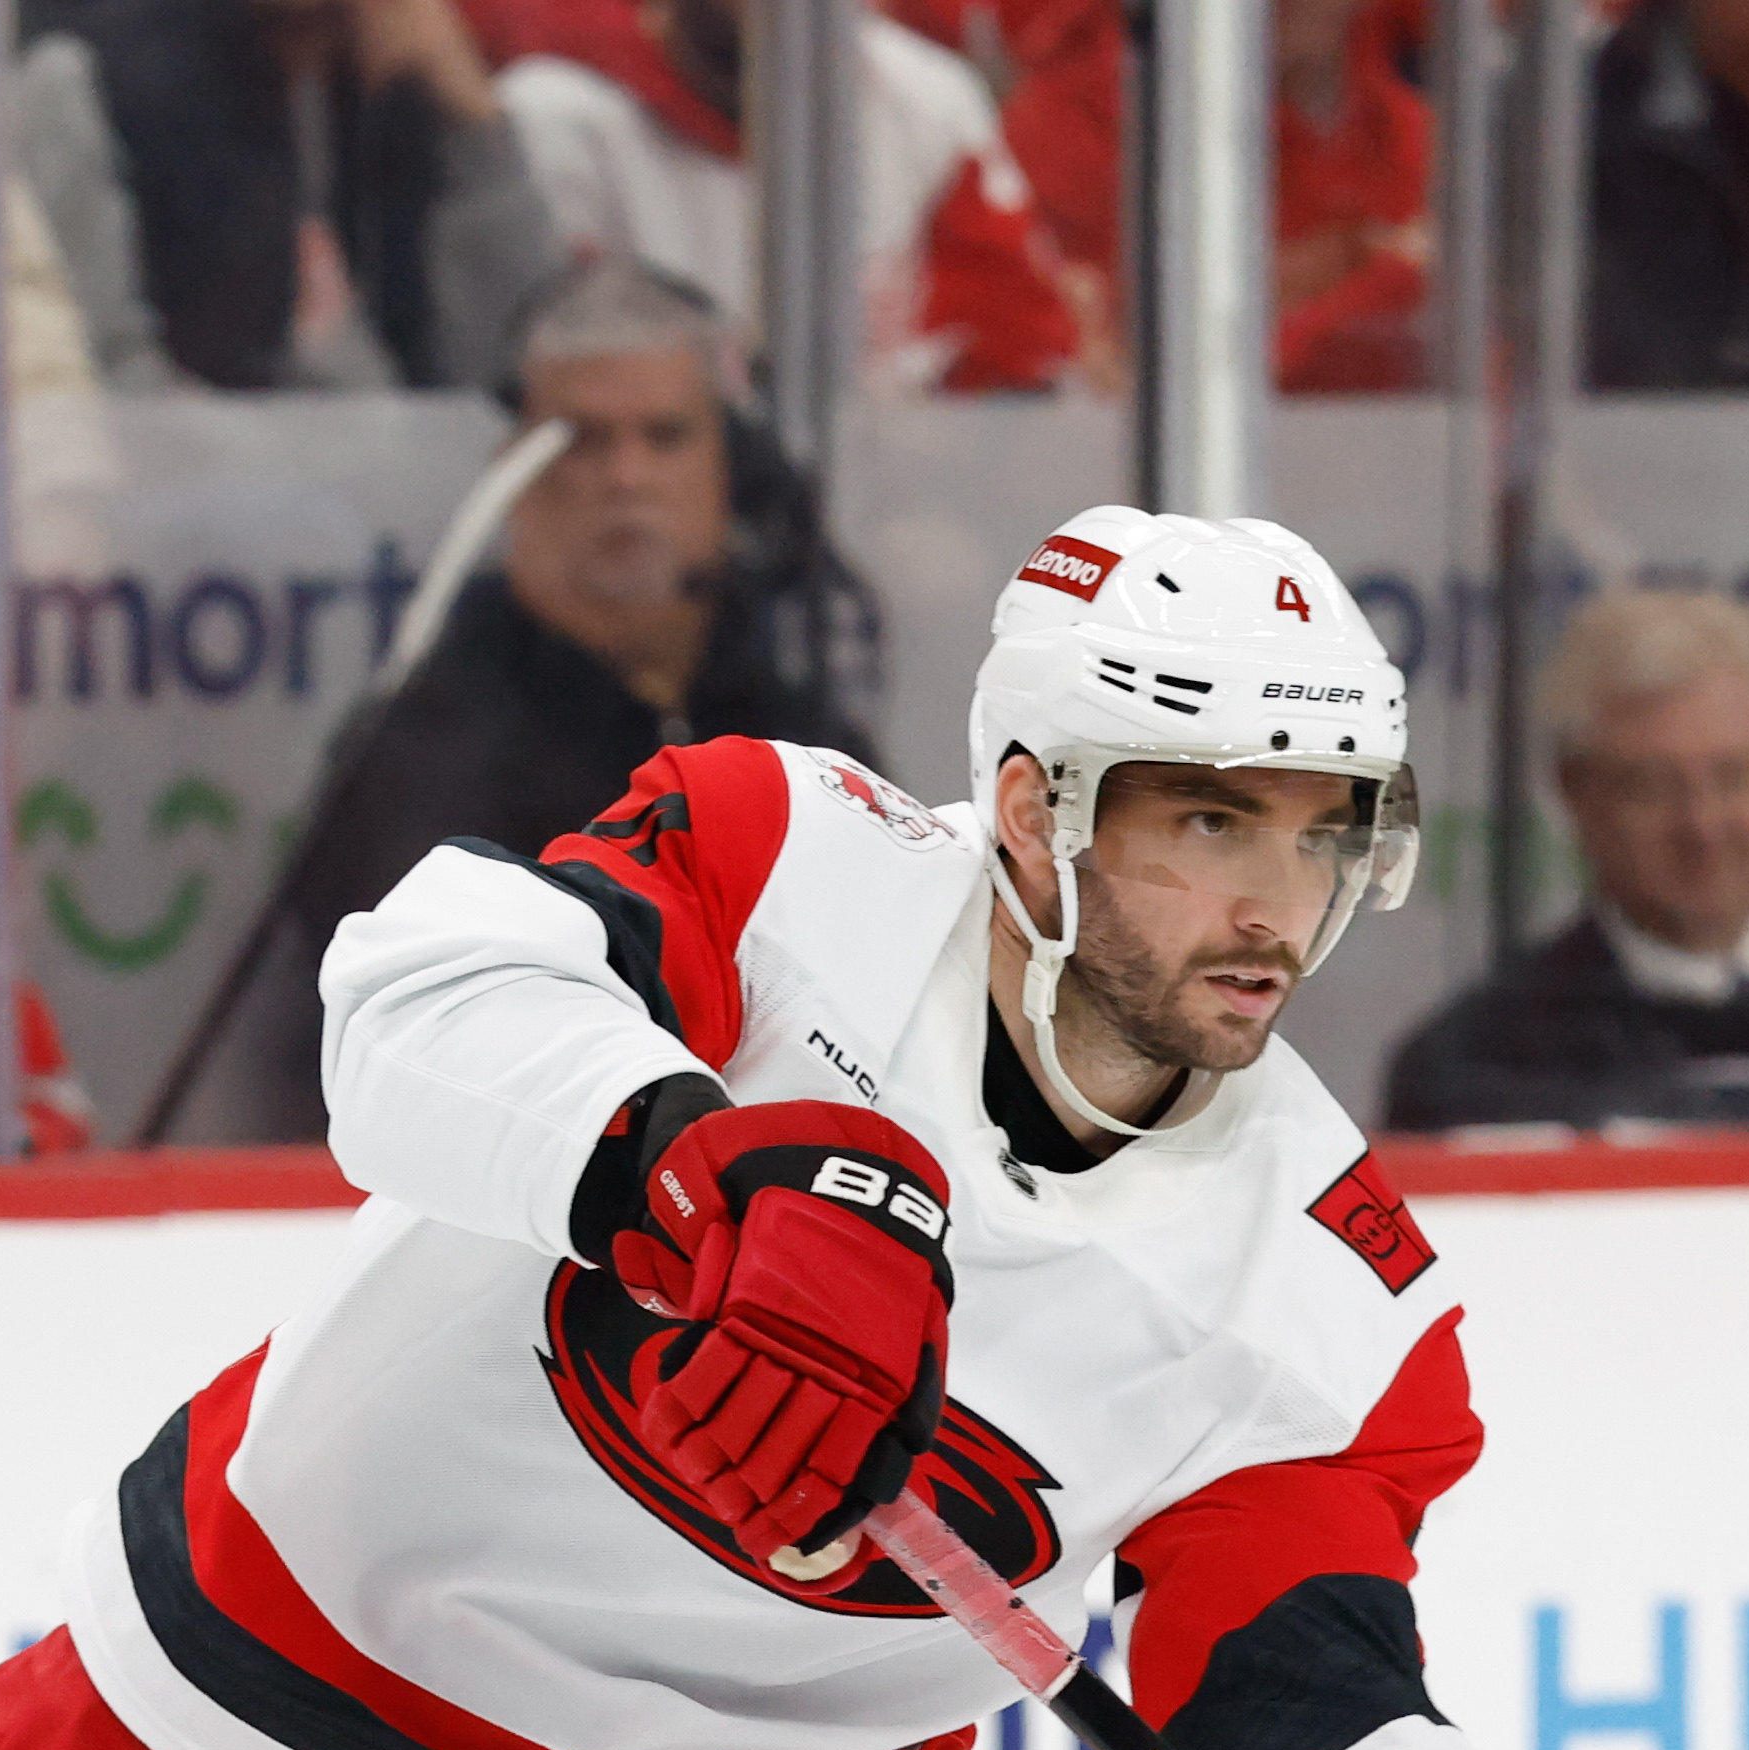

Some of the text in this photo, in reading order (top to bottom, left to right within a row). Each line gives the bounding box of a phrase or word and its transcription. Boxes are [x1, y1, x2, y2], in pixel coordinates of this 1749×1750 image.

[1025, 543, 1102, 586] Lenovo
[1275, 576, 1311, 622] 4
[660, 1170, 696, 1218] GHOST
